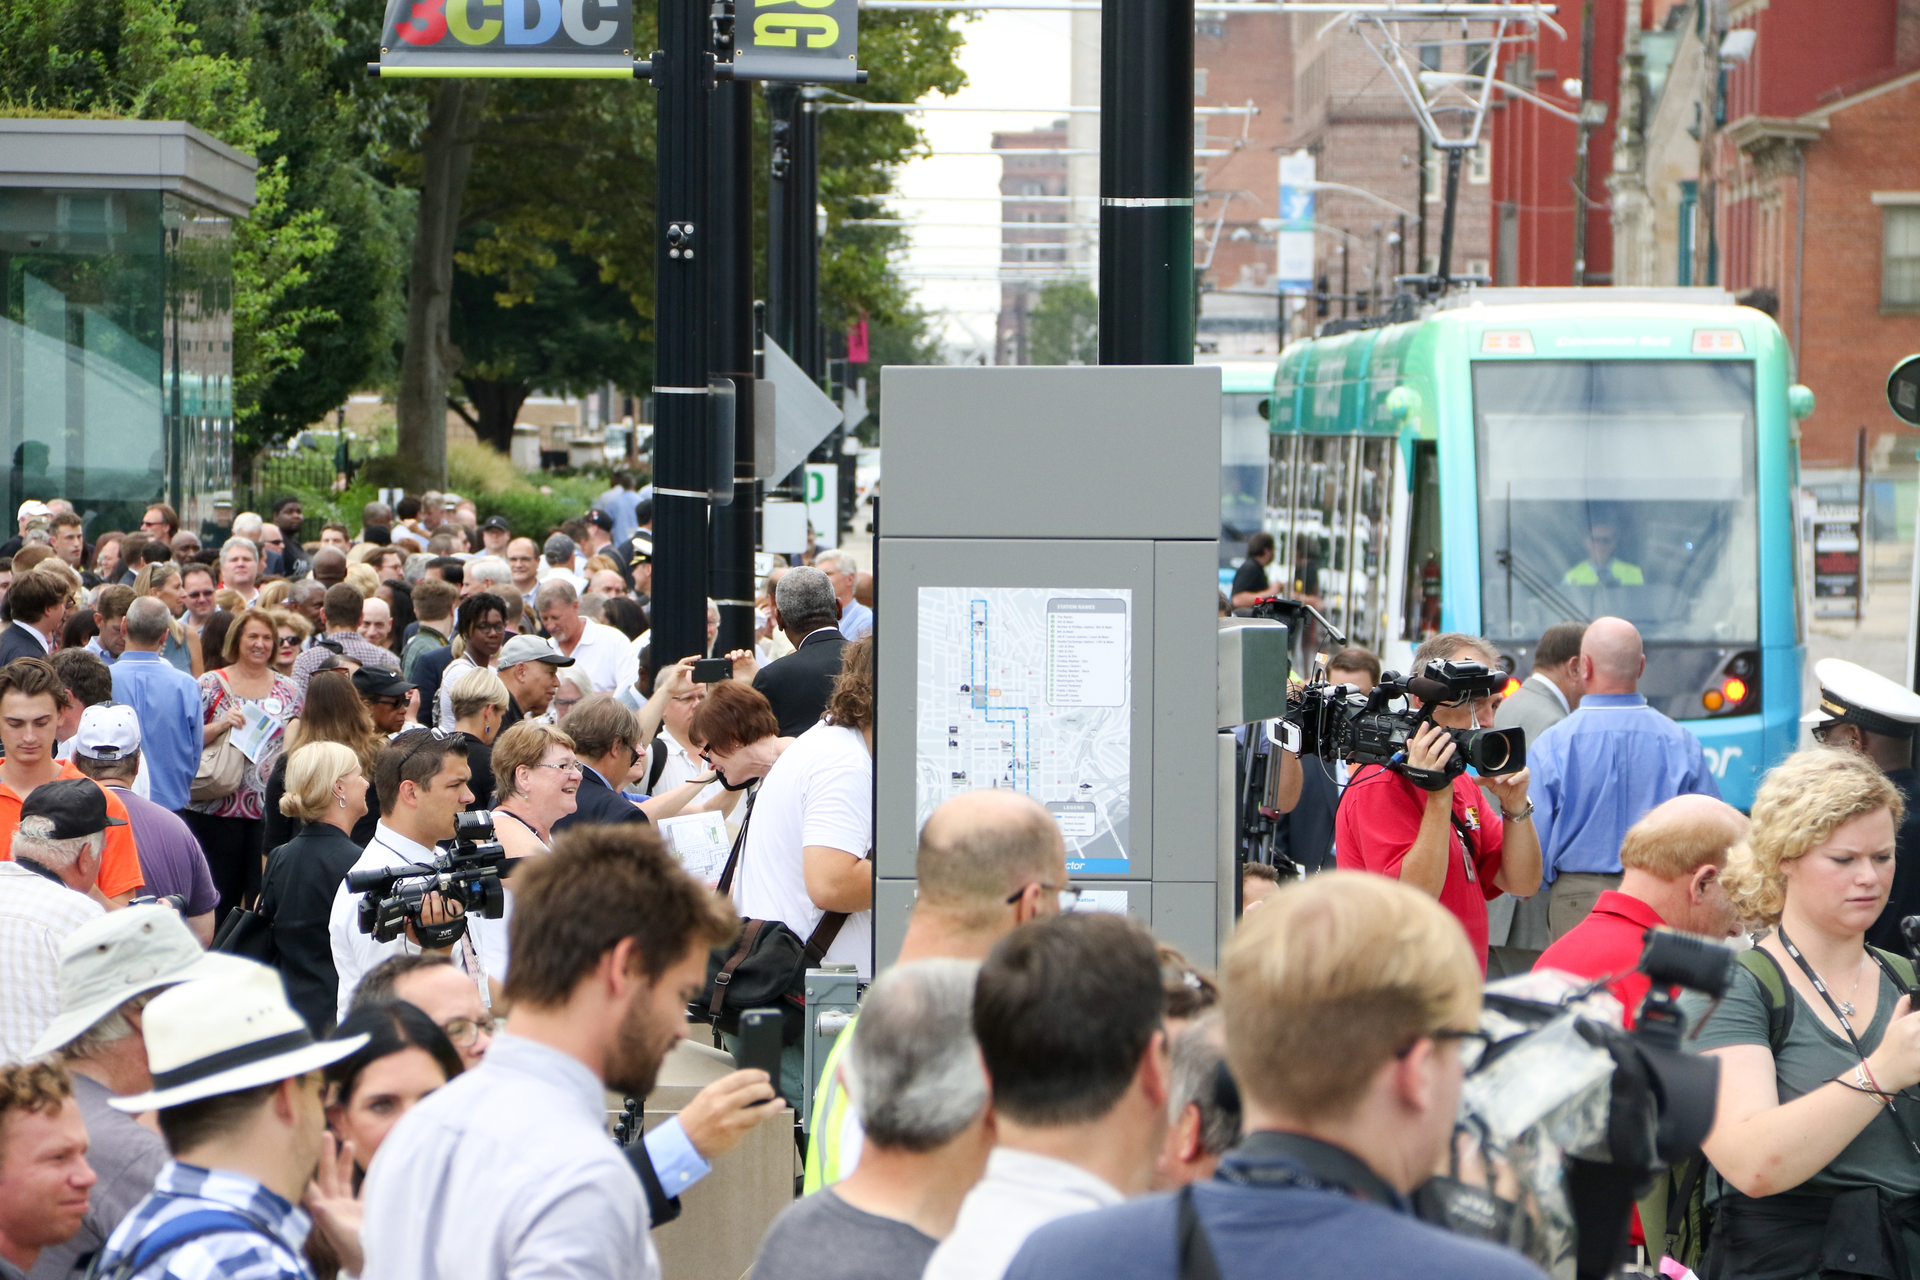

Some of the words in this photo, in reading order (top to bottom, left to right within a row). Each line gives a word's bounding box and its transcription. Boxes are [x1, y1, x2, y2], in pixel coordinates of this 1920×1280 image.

[394, 0, 619, 46] 3CDC
[753, 0, 839, 48] G
[1702, 747, 1743, 778] or
[1065, 861, 1085, 871] ctor
[439, 929, 452, 937] JVC
